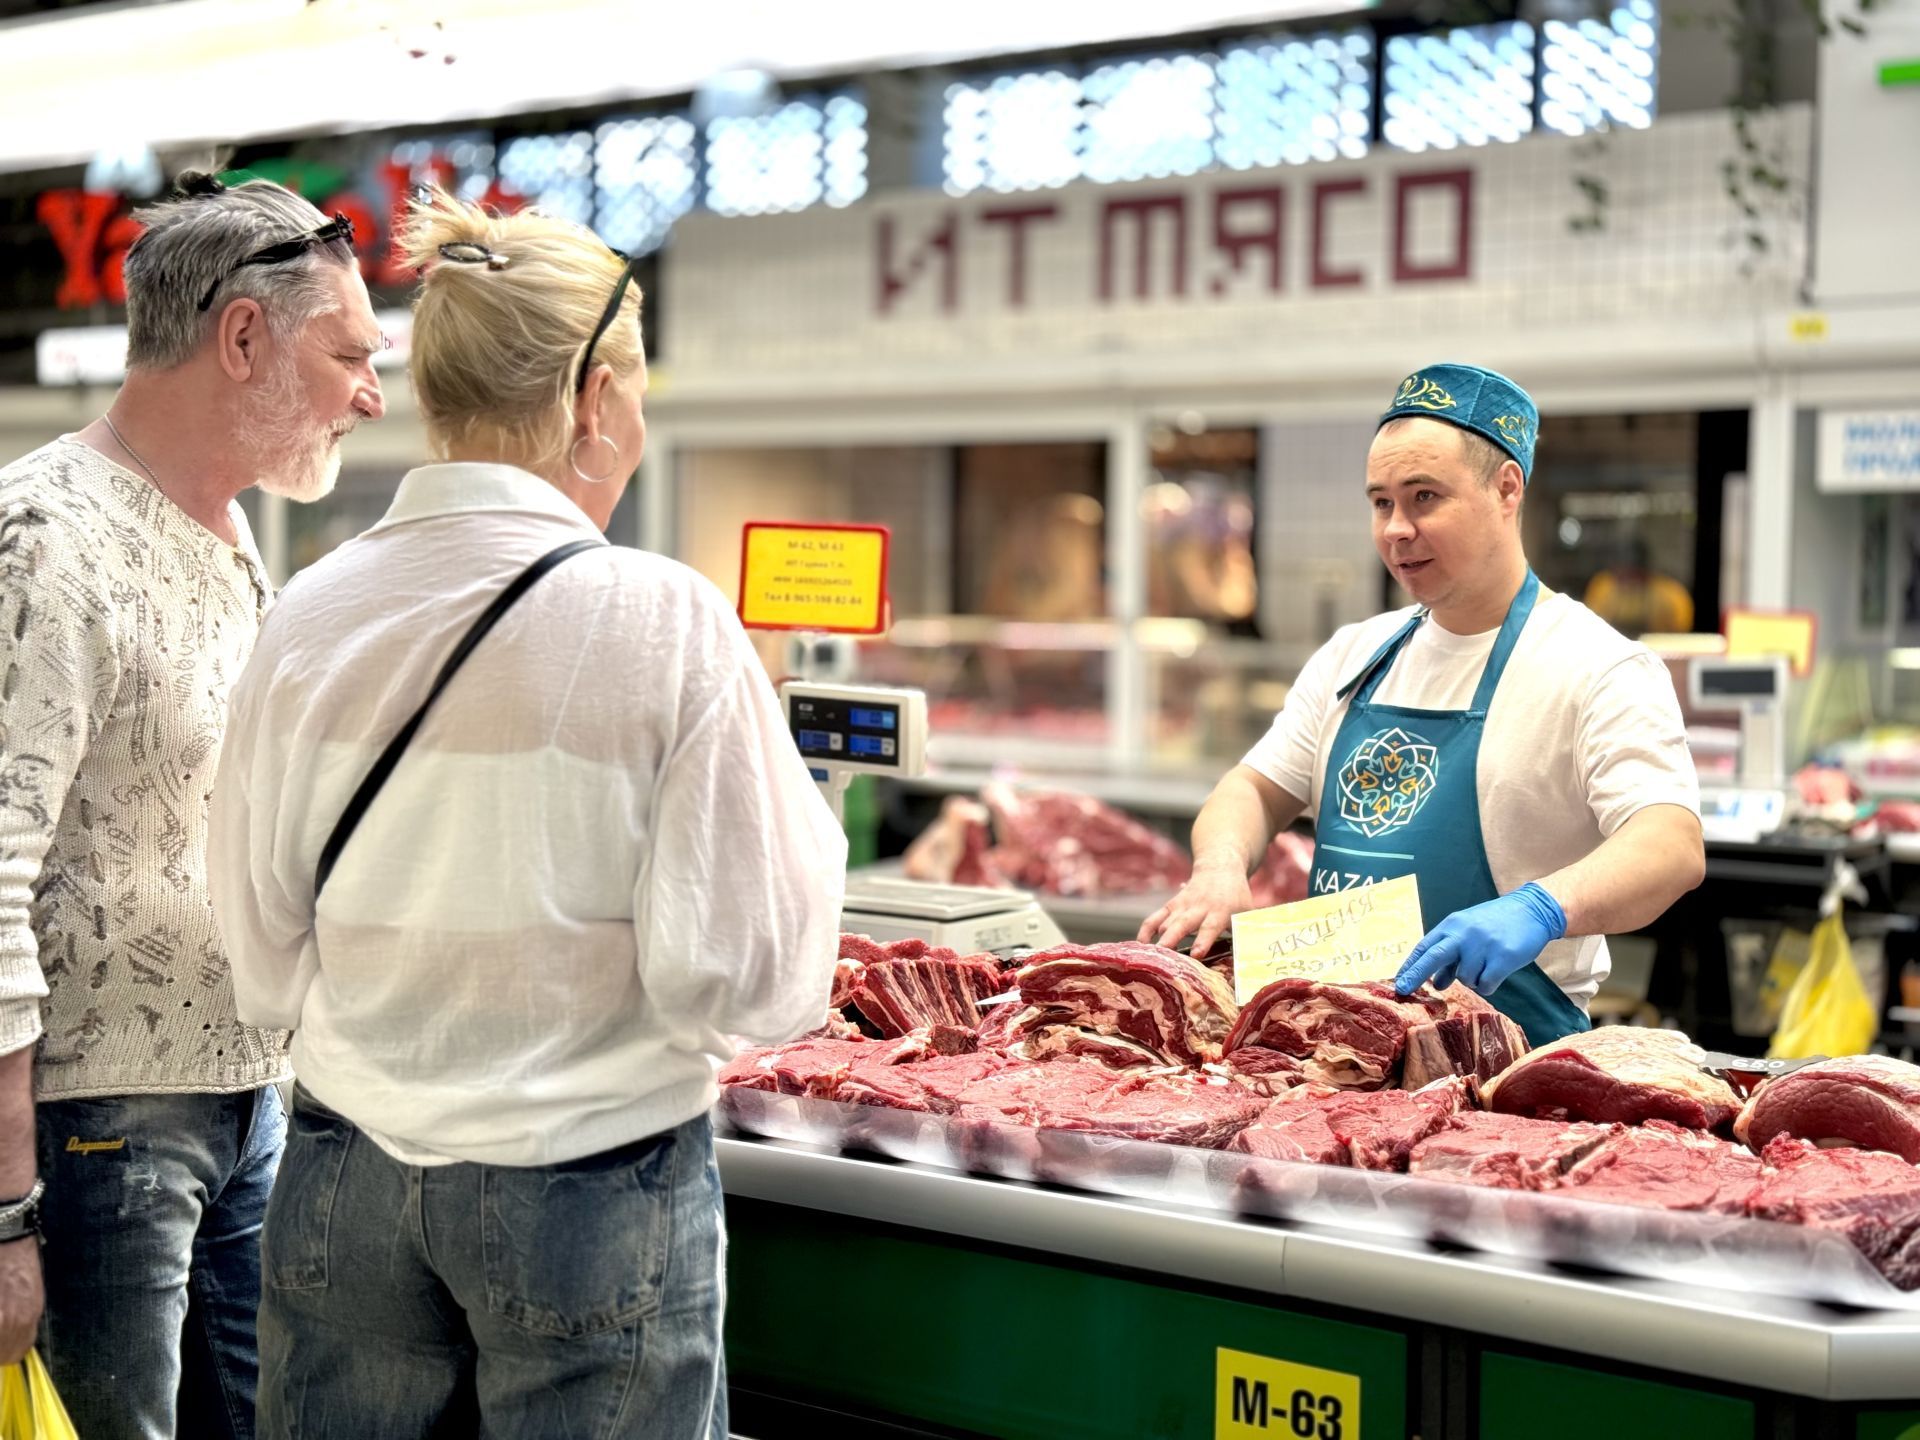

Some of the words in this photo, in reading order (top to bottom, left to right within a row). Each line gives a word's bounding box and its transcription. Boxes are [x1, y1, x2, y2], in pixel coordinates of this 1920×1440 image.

[1099, 168, 1475, 304] МЯСО
[1267, 889, 1377, 966] АКЦИЯ
[1232, 1375, 1343, 1440] М-63
